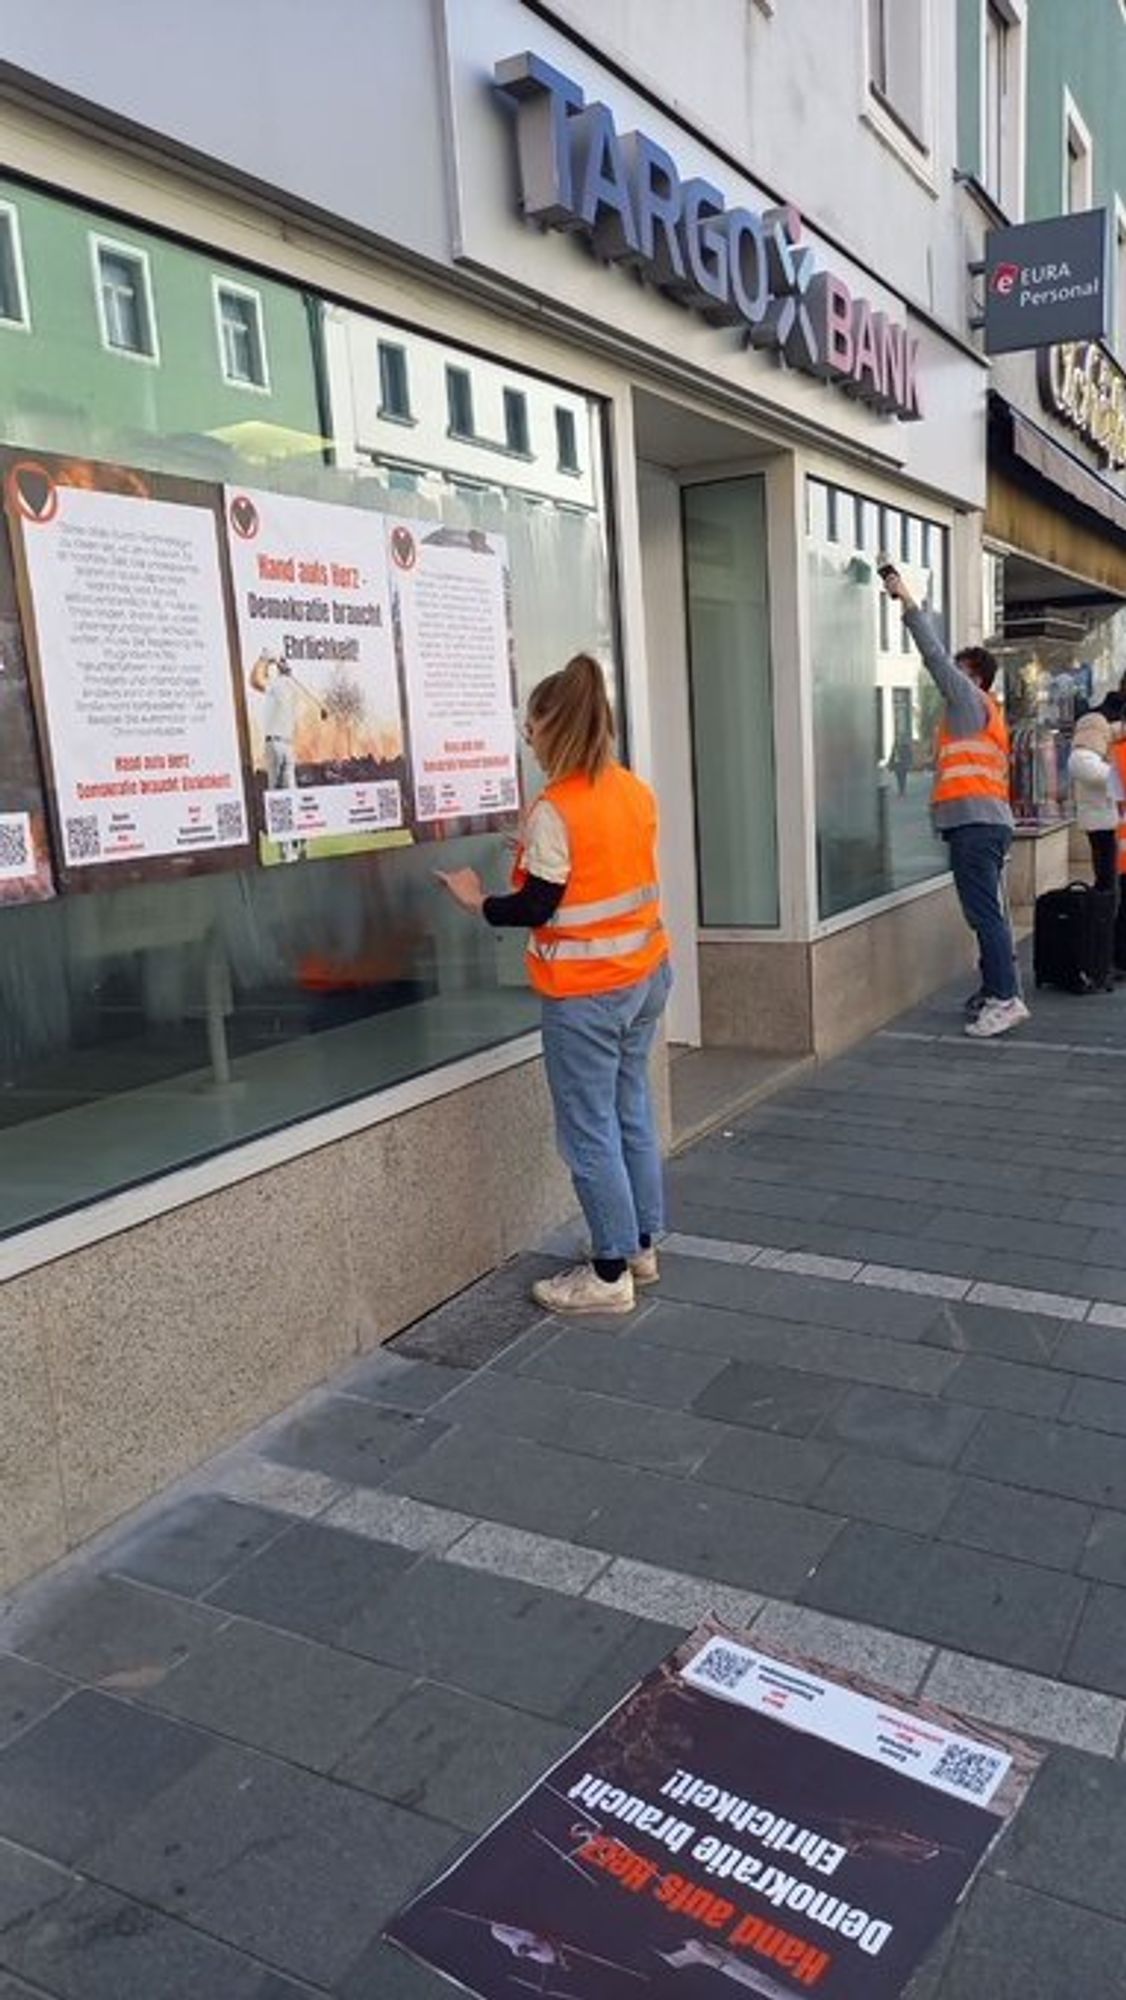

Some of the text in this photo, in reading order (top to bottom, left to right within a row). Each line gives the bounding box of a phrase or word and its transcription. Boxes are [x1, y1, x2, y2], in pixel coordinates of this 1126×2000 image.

[494, 50, 769, 324] TARGO
[822, 270, 924, 420] BANK
[1020, 262, 1071, 287] EURA
[1020, 276, 1099, 308] Personal
[247, 592, 330, 623] Demokratie
[659, 1768, 848, 1876] Ehrlichkeit!
[567, 1772, 893, 1956] Demokratie braucht
[656, 1872, 736, 1928] aufs
[729, 1914, 832, 1986] Hand
